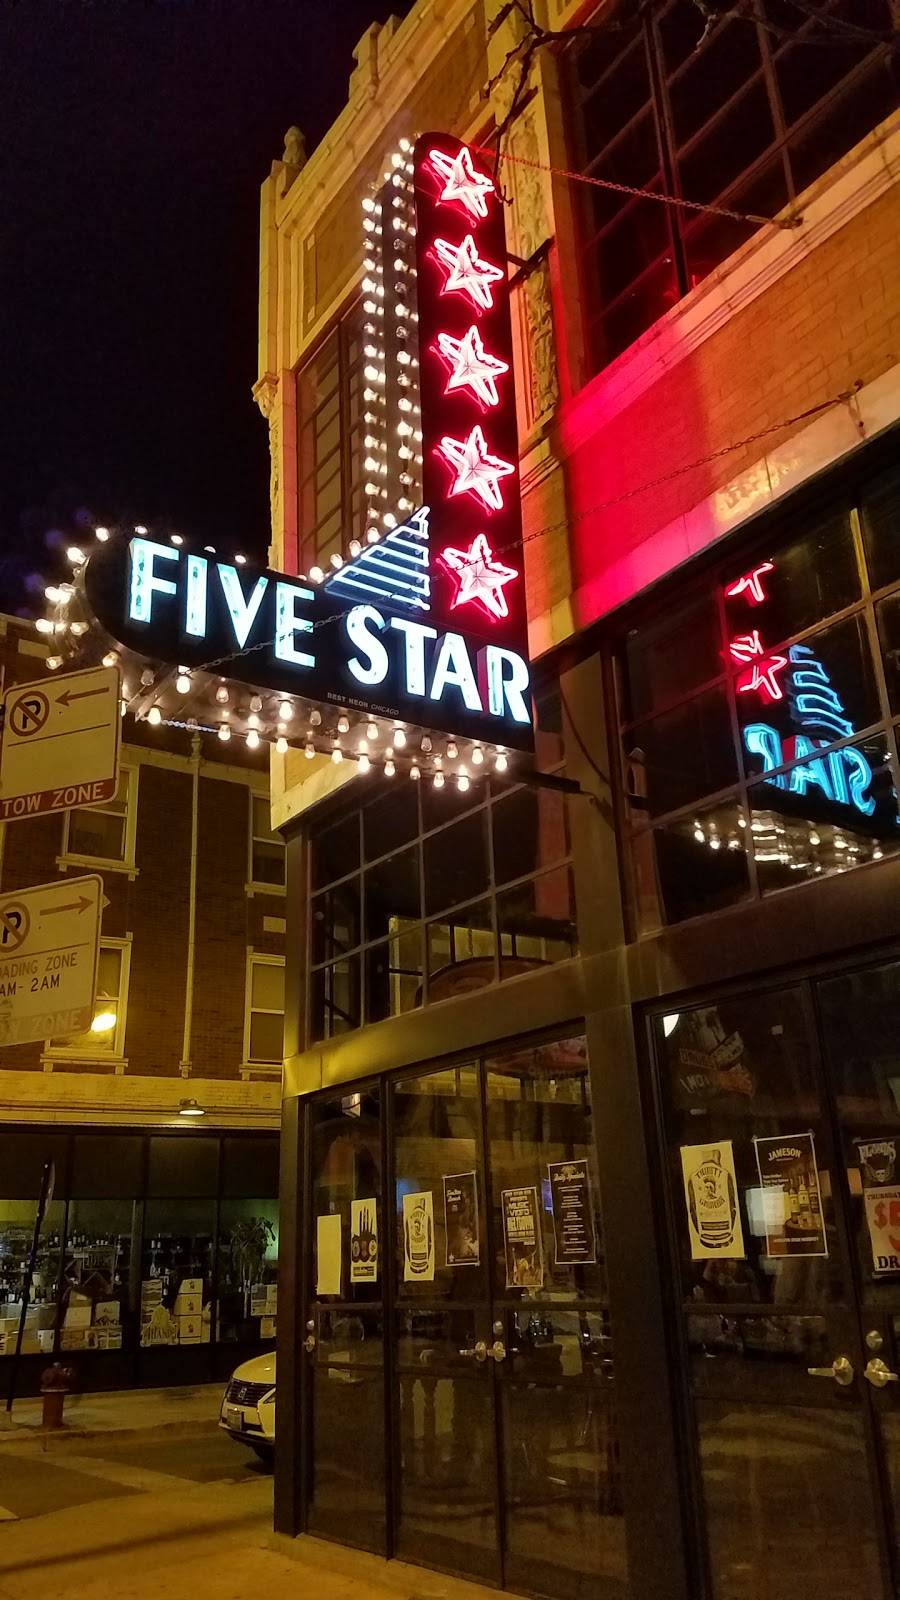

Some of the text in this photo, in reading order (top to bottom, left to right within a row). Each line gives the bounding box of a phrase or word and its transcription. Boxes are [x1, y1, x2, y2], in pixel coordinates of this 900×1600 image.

[128, 537, 531, 724] FIVE STAR
[327, 692, 400, 716] BEST NEON CHICAGO
[2, 782, 105, 817] TOW ZONE
[45, 952, 78, 972] ZONE
[767, 1147, 802, 1161] JAMESON
